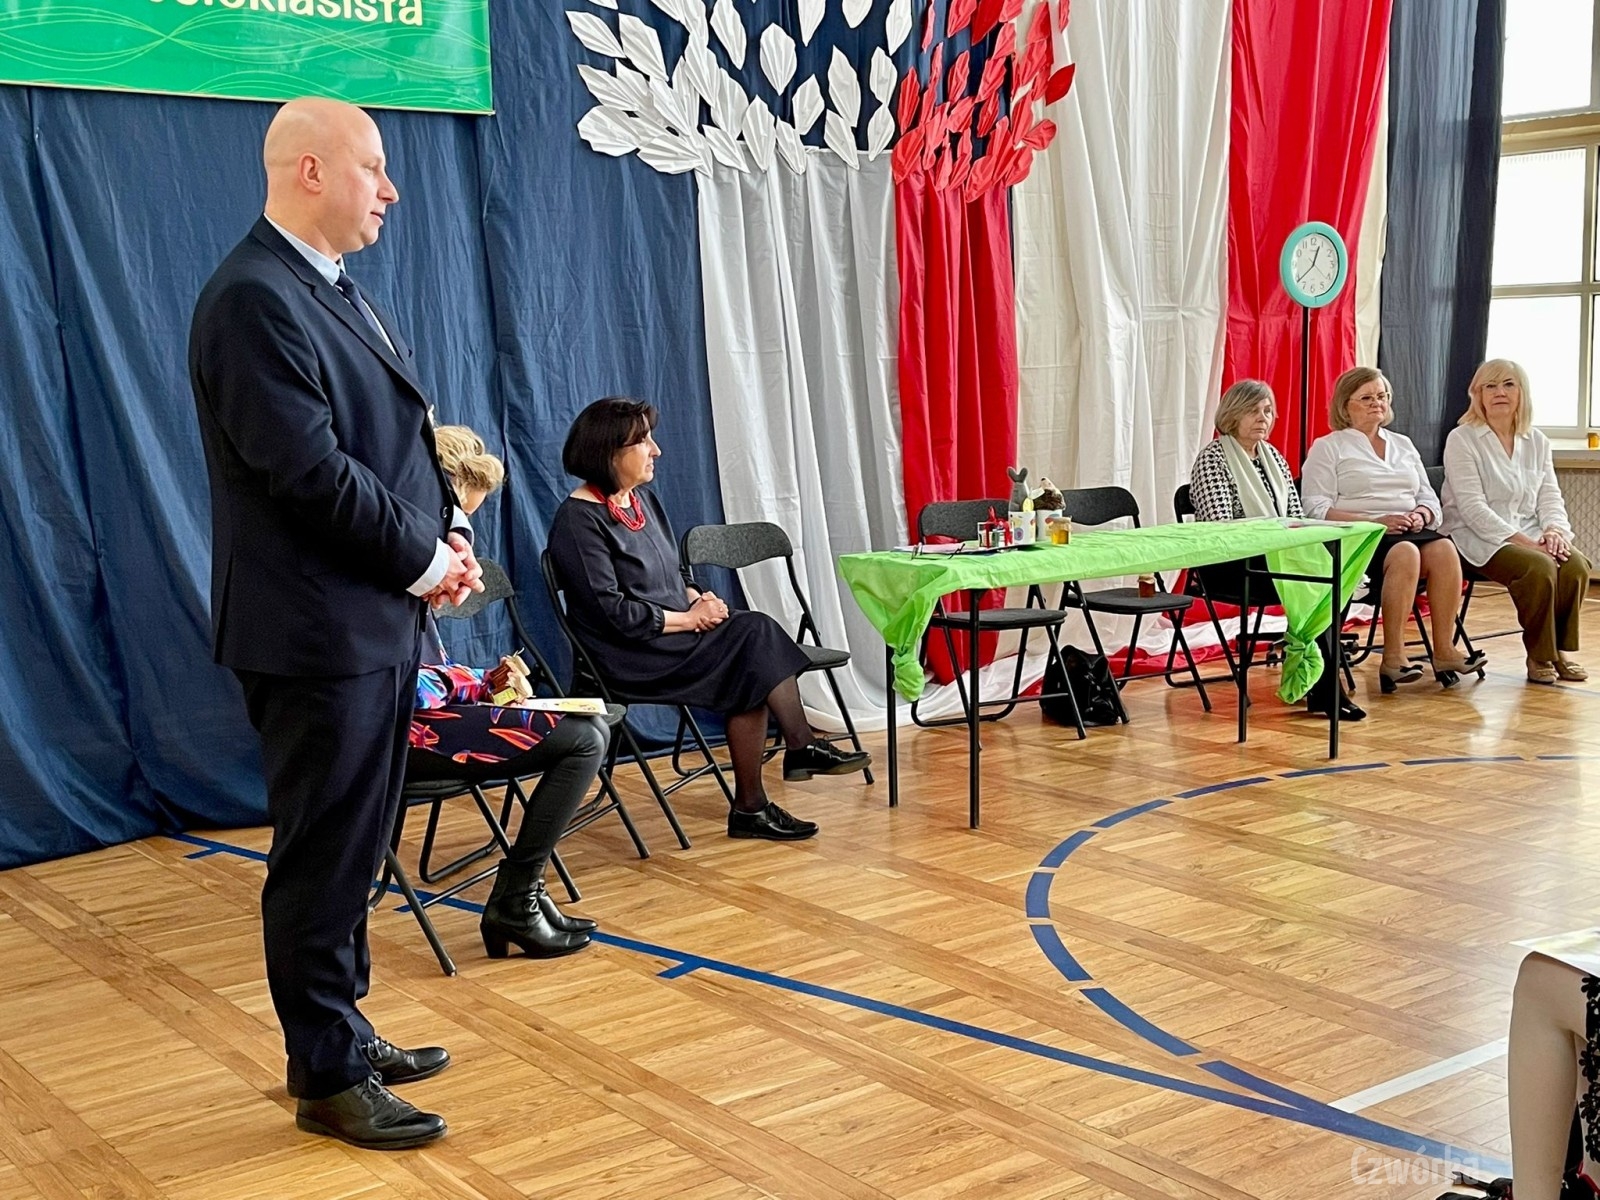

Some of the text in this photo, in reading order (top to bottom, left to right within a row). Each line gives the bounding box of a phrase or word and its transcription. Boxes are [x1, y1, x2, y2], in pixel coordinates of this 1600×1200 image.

[1302, 241, 1308, 249] 11
[1310, 237, 1317, 246] 12
[1327, 248, 1333, 258] 2
[1310, 284, 1316, 294] 6
